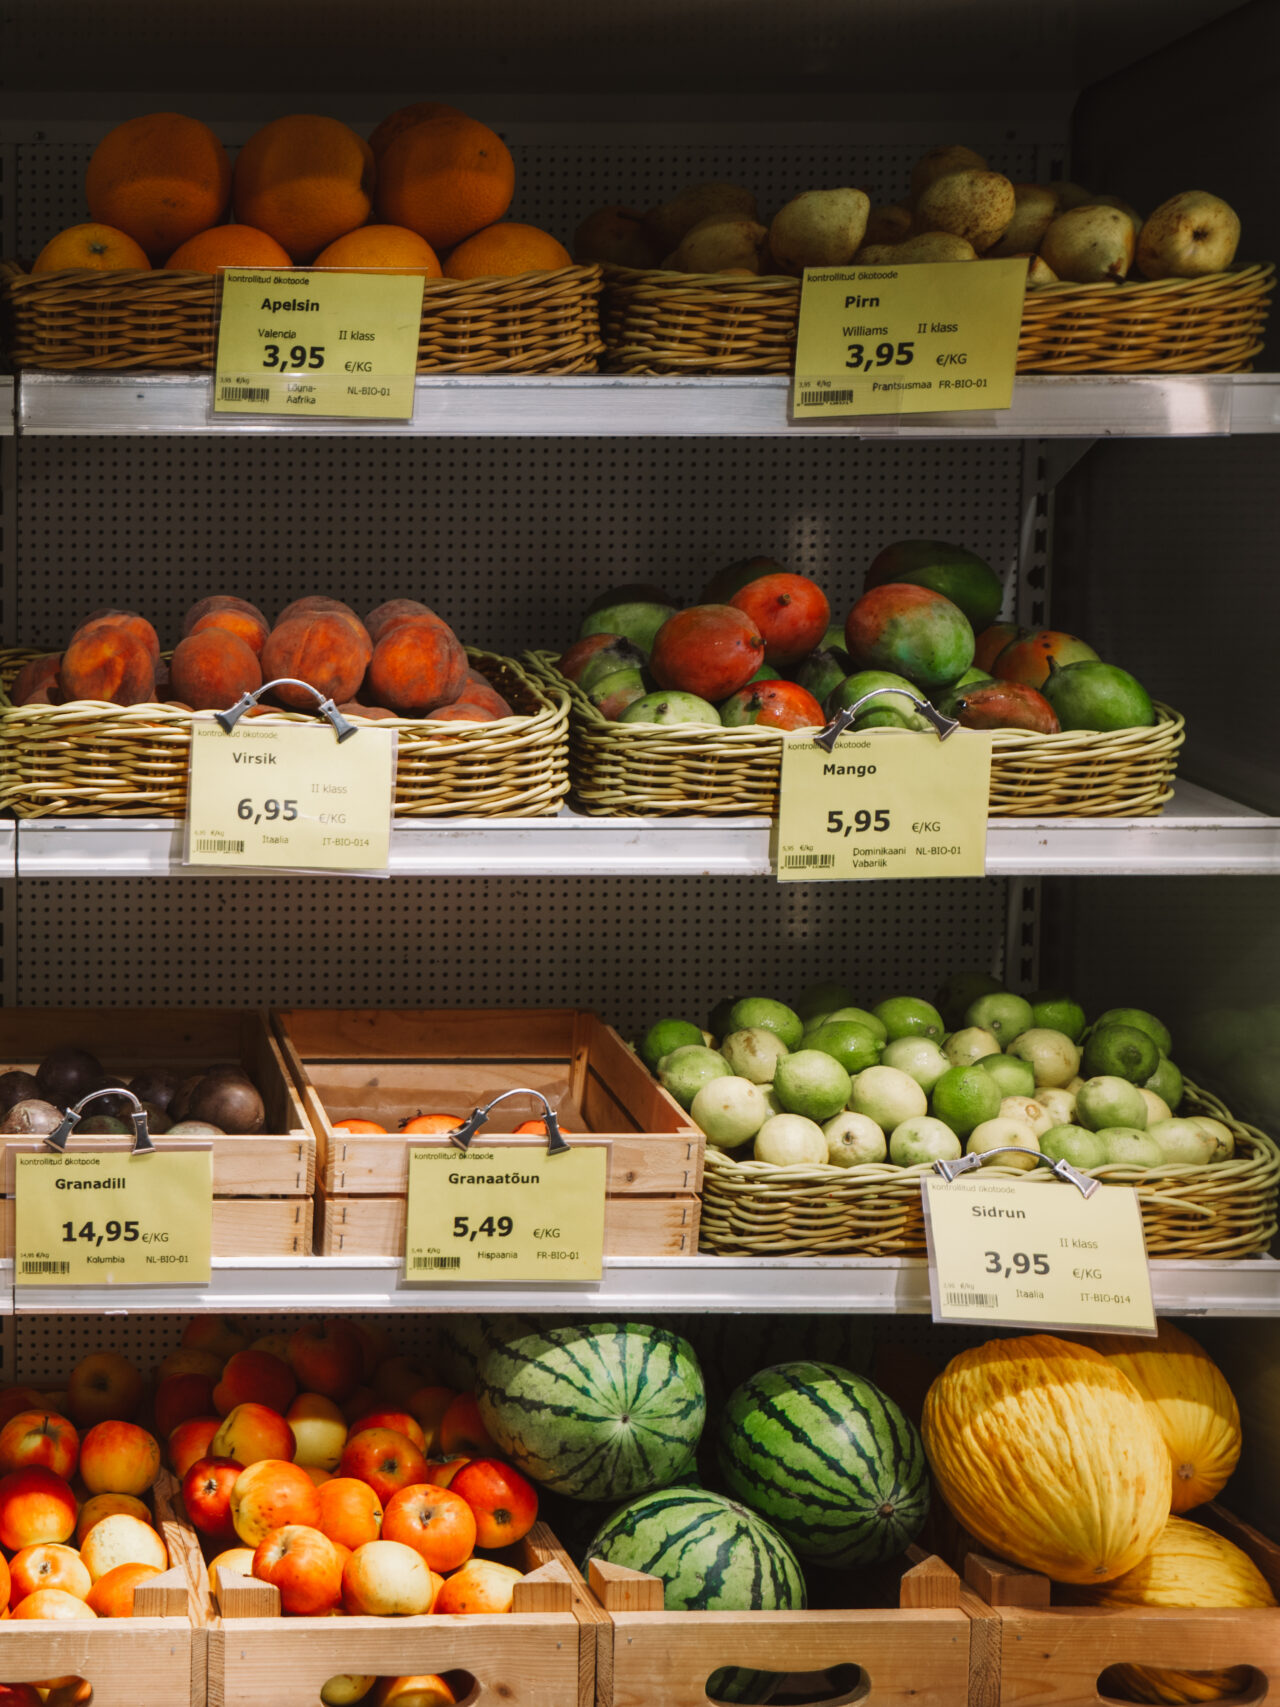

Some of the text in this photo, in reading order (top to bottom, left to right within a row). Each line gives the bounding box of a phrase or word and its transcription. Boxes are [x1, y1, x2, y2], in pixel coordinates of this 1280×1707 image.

[228, 275, 310, 285] kontrollitud ökotoode
[807, 271, 898, 282] kontrollitud ökotoode
[261, 298, 320, 313] Apelsin
[845, 295, 880, 308] Pirn
[258, 328, 375, 341] Valencia II klass
[842, 322, 958, 337] Williams II klass
[262, 345, 372, 373] 3,95 €/KG
[845, 342, 967, 372] 3,95 €/KG
[347, 386, 390, 396] NL-BIO-01
[872, 379, 987, 392] Prantsusmaa FR-BIO-01
[286, 396, 316, 404] Aafrika
[834, 741, 871, 749] ökotoode
[233, 752, 277, 765] Virsik
[823, 764, 877, 777] Mango
[311, 783, 348, 794] II klass
[237, 798, 346, 825] 6,95 €/KG
[827, 809, 941, 838] 5,95 €/KG
[262, 835, 369, 847] Itaalia IT-BIO-014
[853, 846, 961, 857] Dominikaani NL-BIO-01
[20, 1158, 62, 1166] kontrollitud
[414, 1152, 457, 1160] kontrollitud
[55, 1178, 126, 1190] Granadill
[448, 1173, 540, 1185] Granaatõun
[971, 1206, 1026, 1219] Sidrun
[62, 1220, 169, 1247] 14,95 €/KG
[453, 1216, 560, 1242] 5,49 €/KG
[1059, 1237, 1098, 1249] II klass
[86, 1255, 188, 1264] Kolumbia NL-BIO-01
[477, 1251, 579, 1261] Hispaania FR-BIO-01
[984, 1251, 1103, 1280] 3,95 €/KG
[1016, 1289, 1131, 1304] Itaalia IT-BIO-014
